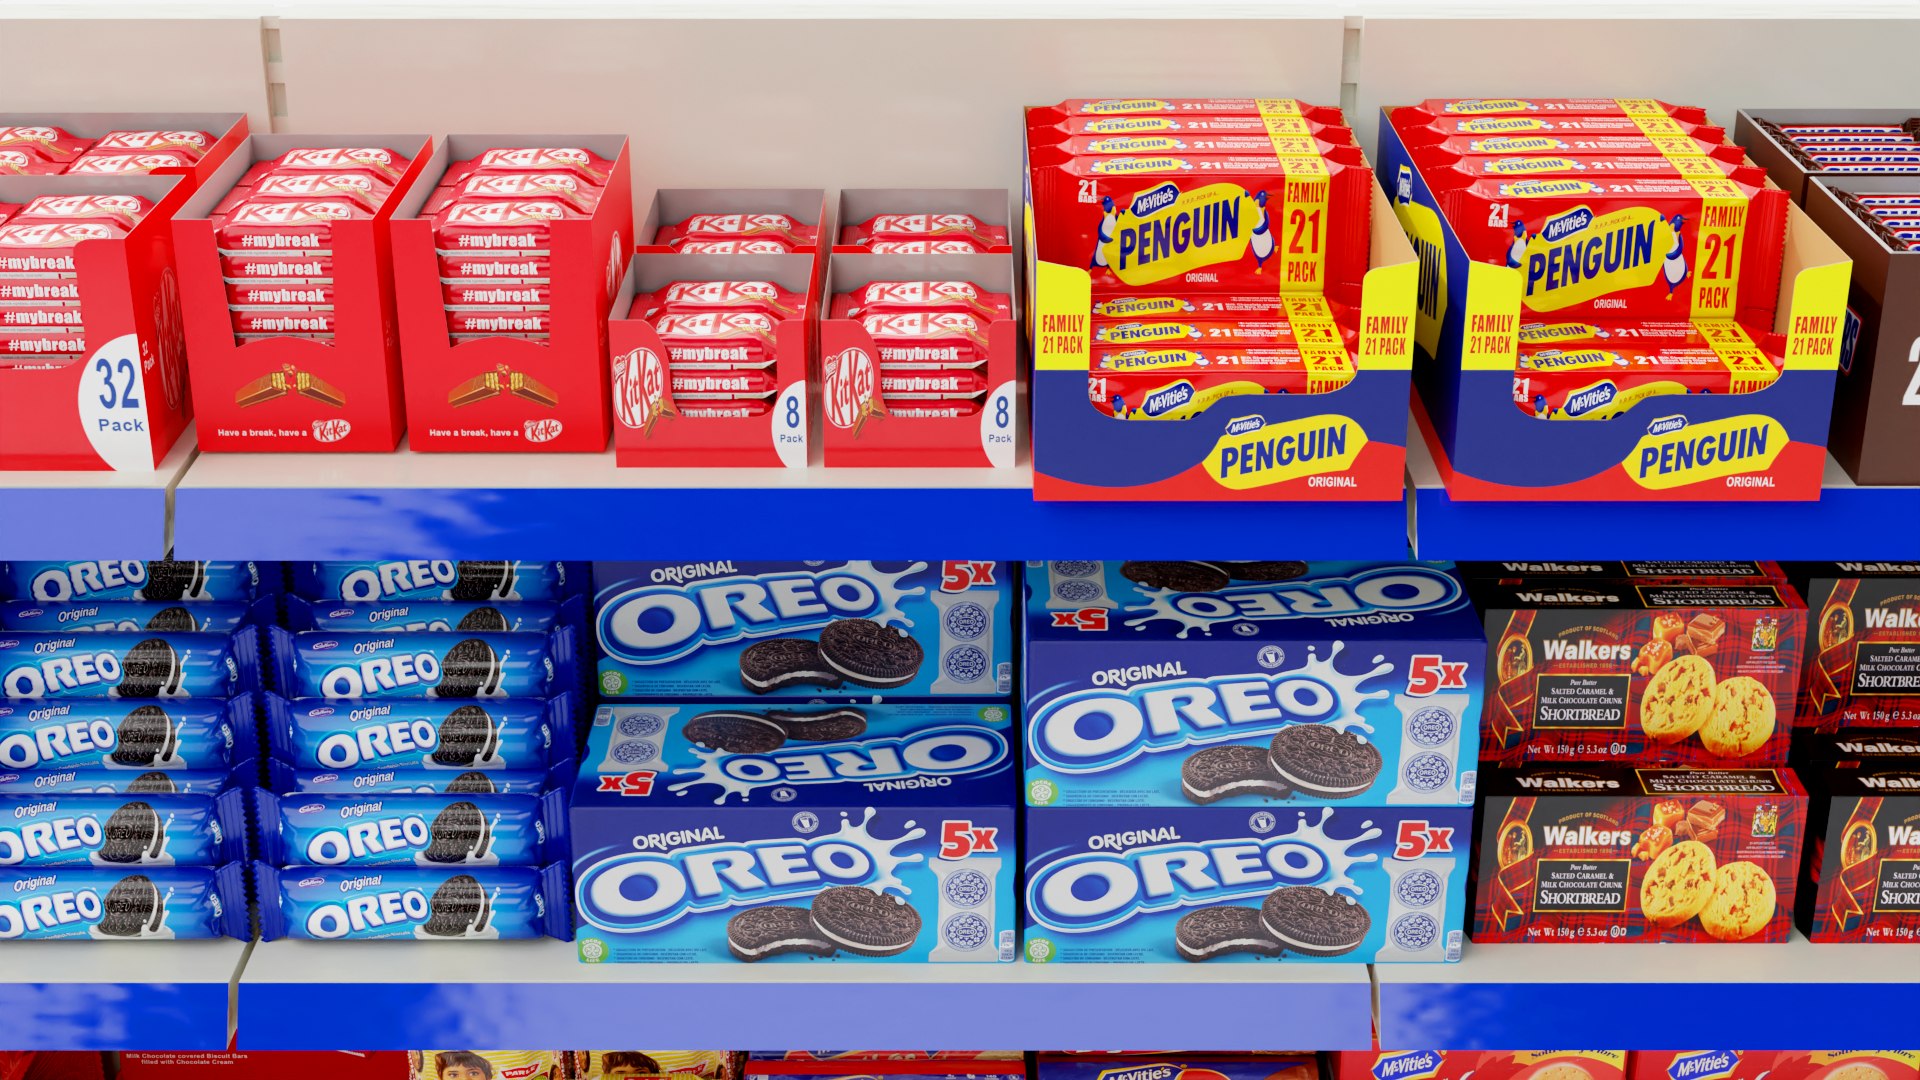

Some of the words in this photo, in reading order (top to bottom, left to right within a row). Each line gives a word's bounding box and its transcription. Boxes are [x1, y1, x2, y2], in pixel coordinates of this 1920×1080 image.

[105, 132, 204, 147] KitKat
[486, 148, 588, 166] KitKat
[263, 175, 370, 193] KitKat
[1078, 180, 1097, 196] 21
[1287, 182, 1327, 203] FAMILY
[1513, 182, 1583, 195] PENGUIN
[29, 196, 140, 214] KitKat
[1078, 195, 1097, 203] BARS
[1137, 188, 1174, 214] McVitie's
[455, 203, 561, 222] KitKat
[1489, 203, 1509, 220] 21
[1703, 206, 1745, 227] FAMILY
[697, 214, 789, 232] KitKat
[1289, 209, 1321, 254] 21
[1488, 219, 1508, 228] BARS
[1548, 211, 1587, 239] McVitie's
[242, 234, 319, 248] #mybreak
[1119, 195, 1240, 271] PENGUIN
[0, 256, 75, 270] #mybreak
[1526, 219, 1655, 296] PENGUIN
[1701, 233, 1737, 280] 21
[245, 262, 322, 276] #mybreak
[1186, 273, 1218, 283] ORIGINAL
[1287, 261, 1316, 282] PACK
[463, 289, 540, 303] #mybreak
[675, 281, 776, 303] KitKat
[876, 281, 977, 303] KitKat
[1698, 287, 1730, 309] PACK
[1105, 299, 1174, 314] PENGUIN
[1594, 299, 1627, 309] ORIGINAL
[4, 310, 82, 325] #mybreak
[1042, 314, 1085, 332] FAMILY
[1366, 316, 1408, 334] FAMILY
[1471, 315, 1514, 333] FAMILY
[1110, 325, 1180, 340] PENGUIN
[1518, 325, 1587, 340] PENGUIN
[1043, 336, 1054, 354] 21
[1057, 336, 1084, 354] PACK
[1365, 338, 1377, 355] 21
[1379, 337, 1406, 355] PACK
[1470, 336, 1482, 354] 21
[1484, 336, 1511, 354] PACK
[1114, 352, 1187, 368] PENGUIN
[1216, 355, 1239, 364] 21
[1311, 356, 1344, 365] 21
[1634, 355, 1660, 365] 21
[95, 358, 140, 408] 32
[619, 350, 662, 426] KitKat
[672, 377, 749, 391] #mybreak
[829, 350, 872, 426] KitKat
[882, 377, 958, 391] #mybreak
[1149, 386, 1188, 413] McVitie's
[1570, 386, 1611, 414] McVitie's
[786, 395, 800, 428] 8
[995, 395, 1009, 428] 8
[99, 419, 144, 431] Pack
[218, 429, 239, 437] Have
[250, 429, 276, 438] break,
[279, 429, 299, 437] have
[319, 420, 350, 442] KitKat
[430, 429, 451, 437] Have
[461, 429, 488, 438] break,
[491, 429, 511, 437] have
[1230, 419, 1260, 434] McVitie's
[1652, 418, 1683, 434] McVitie's
[780, 434, 803, 443] Pack
[989, 434, 1012, 443] Pack
[1220, 423, 1347, 479] PENGUIN
[1639, 424, 1769, 479] PENGUIN
[1308, 476, 1357, 487] ORIGINAL
[1726, 476, 1775, 487] ORIGINAL
[650, 560, 738, 583] ORIGINAL
[1502, 562, 1603, 572] Walkers
[1177, 575, 1446, 617] OREO
[1515, 593, 1620, 602] Walkers
[1652, 597, 1775, 605] SHORTBREAD
[369, 607, 409, 622] Original
[610, 577, 875, 649] OREO
[1324, 613, 1414, 628] ORIGINAL
[34, 638, 76, 653] Original
[1543, 639, 1632, 661] Walkers
[4, 652, 121, 698] OREO
[321, 653, 440, 698] OREO
[1092, 661, 1187, 687] ORIGINAL
[1551, 687, 1575, 695] SALTED
[1576, 687, 1607, 695] CARAMEL
[1045, 679, 1333, 757] OREO
[1540, 705, 1621, 721] SHORTBREAD
[318, 720, 437, 768] OREO
[1528, 745, 1541, 754] Net
[1544, 745, 1555, 754] Wt
[726, 735, 994, 781] OREO
[863, 776, 952, 793] ORIGINAL
[1515, 777, 1620, 788] Walkers
[1652, 784, 1775, 792] SHORTBREAD
[14, 802, 57, 818] Original
[341, 802, 383, 819] Original
[1558, 812, 1584, 824] PRODUCT
[307, 817, 428, 865] OREO
[535, 820, 545, 845] OREO
[632, 826, 725, 850] ORIGINAL
[1088, 826, 1181, 850] ORIGINAL
[1543, 825, 1632, 846] Walkers
[340, 875, 382, 892] Original
[590, 843, 870, 917] OREO
[1042, 843, 1323, 917] OREO
[1551, 872, 1575, 880] SALTED
[1576, 872, 1607, 880] CARAMEL
[1608, 872, 1614, 880] &
[1540, 889, 1621, 905] SHORTBREAD
[307, 890, 428, 938] OREO
[1528, 927, 1541, 937] Net
[1544, 927, 1555, 937] Wt
[505, 1065, 538, 1077] PARLE
[1382, 1053, 1433, 1077] McVitie's
[1677, 1054, 1730, 1077] McVitie's
